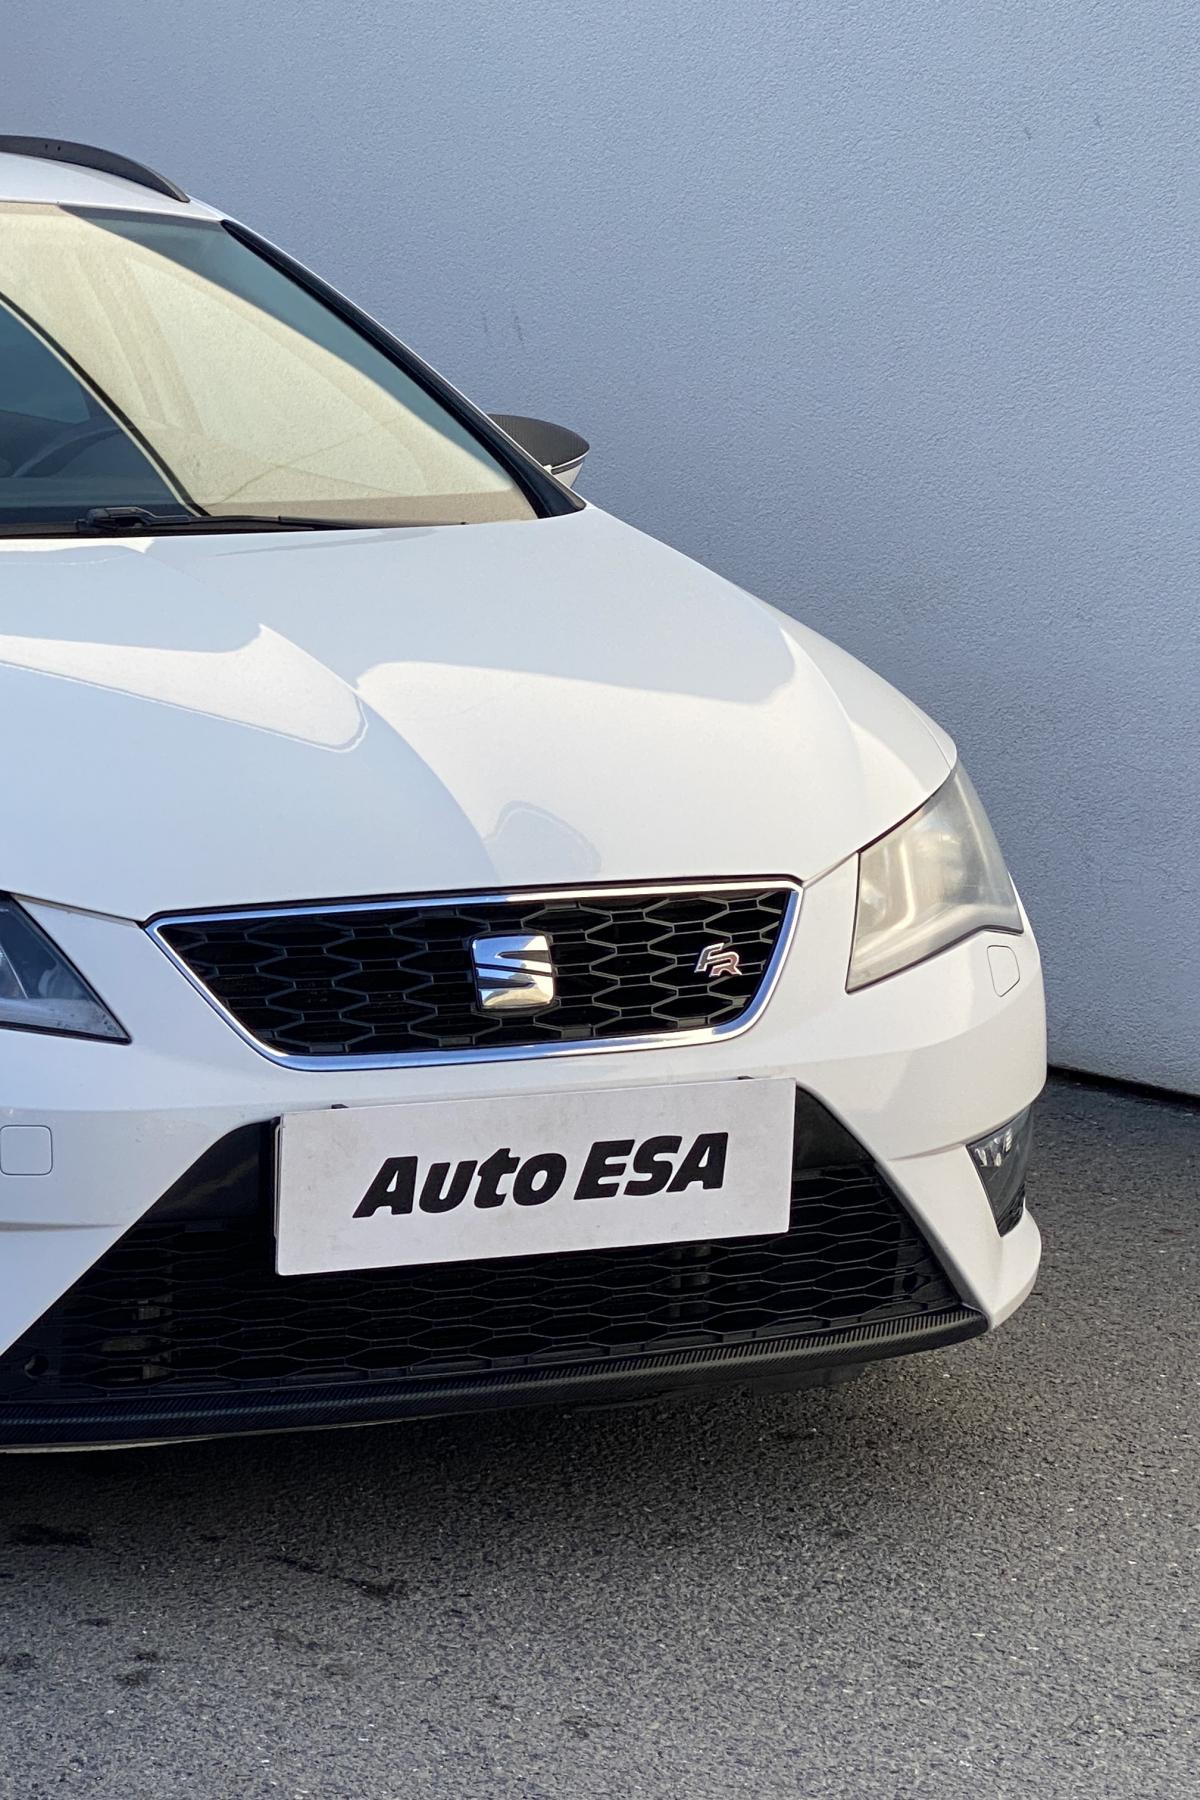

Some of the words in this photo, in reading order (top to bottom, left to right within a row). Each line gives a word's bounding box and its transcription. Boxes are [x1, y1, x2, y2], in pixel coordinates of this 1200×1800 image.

[694, 942, 742, 977] FR
[352, 1147, 567, 1218] Auto
[573, 1131, 729, 1200] ESA
